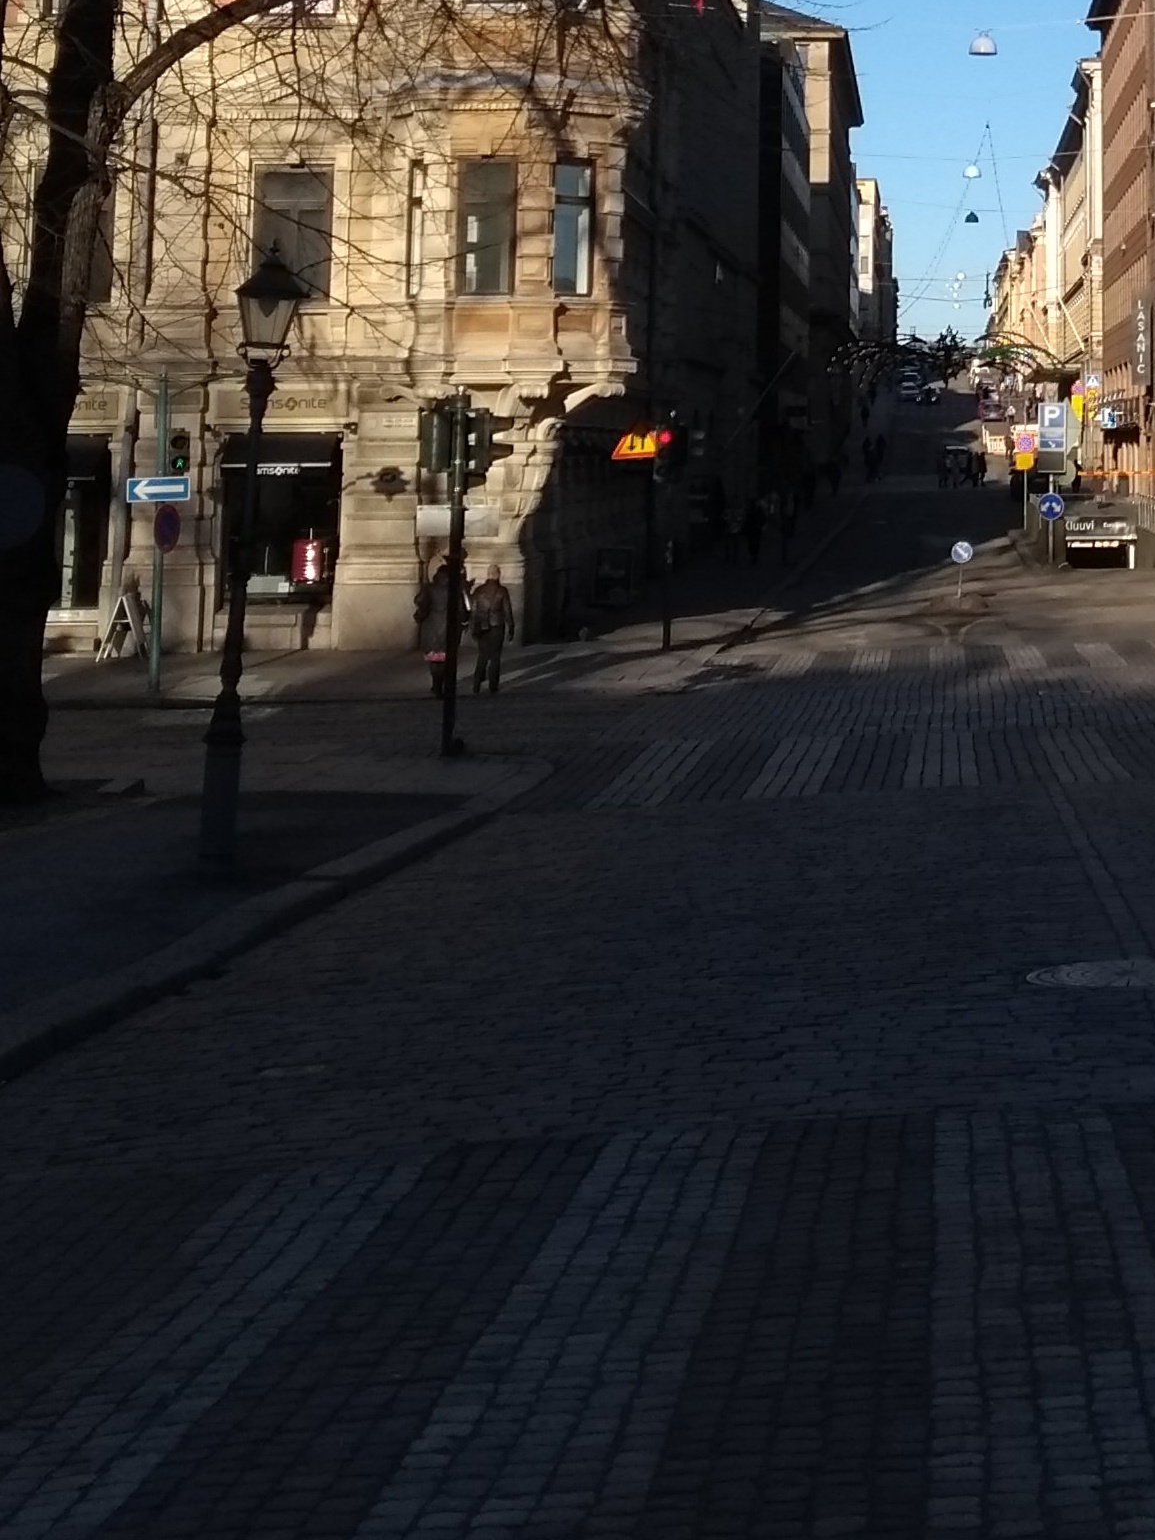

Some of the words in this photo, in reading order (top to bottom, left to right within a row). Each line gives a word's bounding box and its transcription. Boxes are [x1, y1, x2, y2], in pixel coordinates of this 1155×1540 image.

[1136, 299, 1146, 374] LASANIC
[240, 397, 327, 411] Smsonite
[1043, 405, 1060, 427] P
